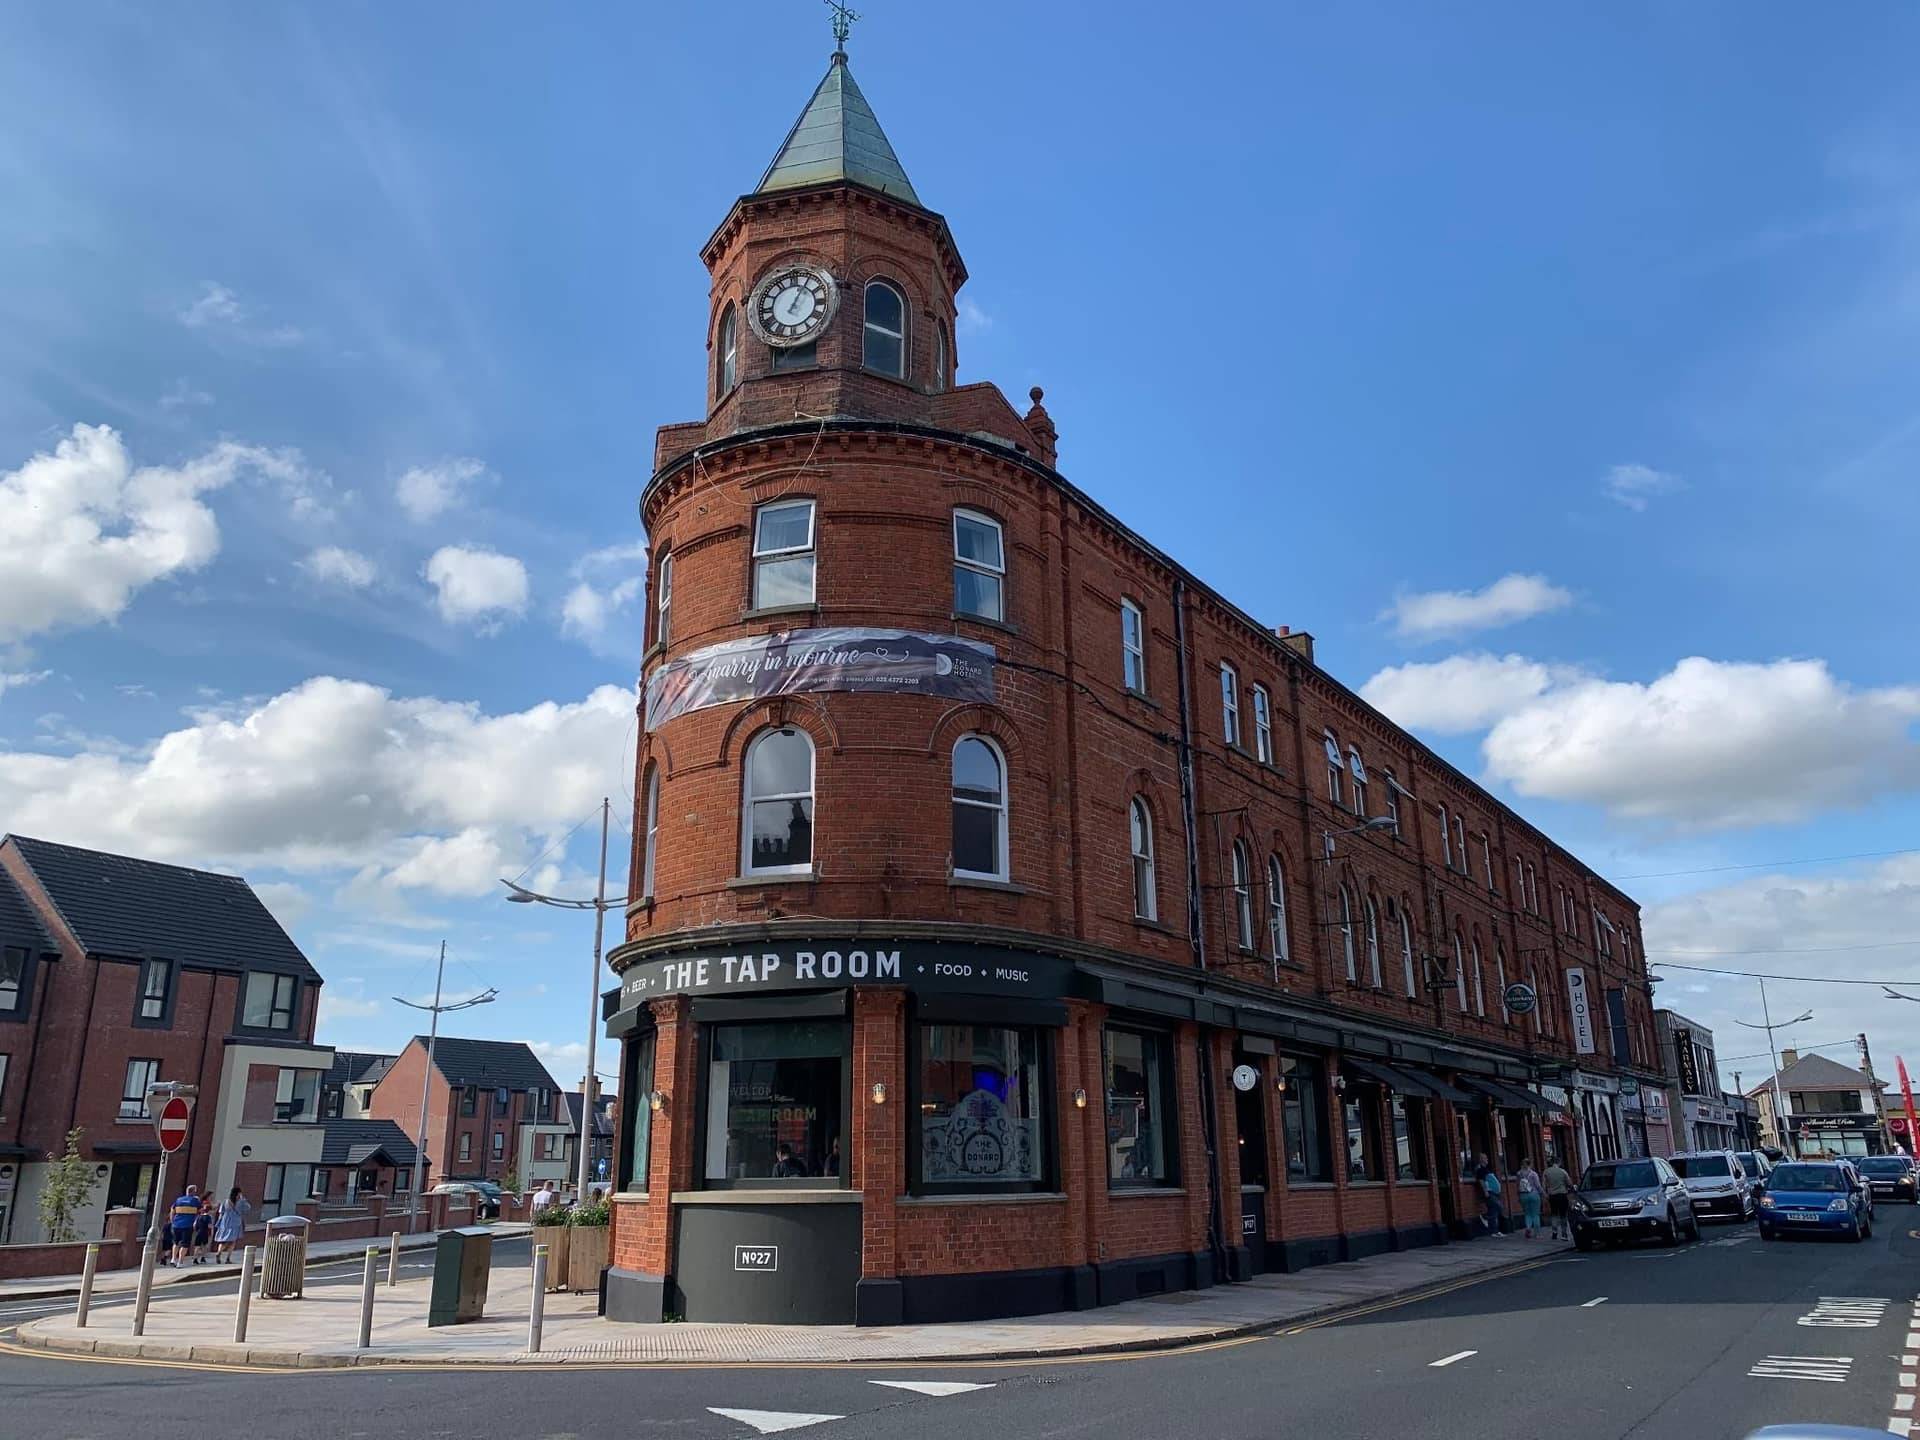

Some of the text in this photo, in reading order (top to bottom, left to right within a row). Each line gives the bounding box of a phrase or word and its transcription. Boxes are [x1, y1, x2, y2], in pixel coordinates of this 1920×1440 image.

[765, 651, 783, 671] in
[955, 658, 969, 667] THE
[663, 951, 901, 990] THE TAP ROOM
[935, 962, 1029, 982] FOOD MUSIC
[631, 978, 647, 994] BEER
[1574, 991, 1588, 1048] HOTEL
[1679, 1031, 1695, 1092] PHARMACY
[771, 1106, 816, 1122] ROOM
[967, 1152, 999, 1161] DONARD
